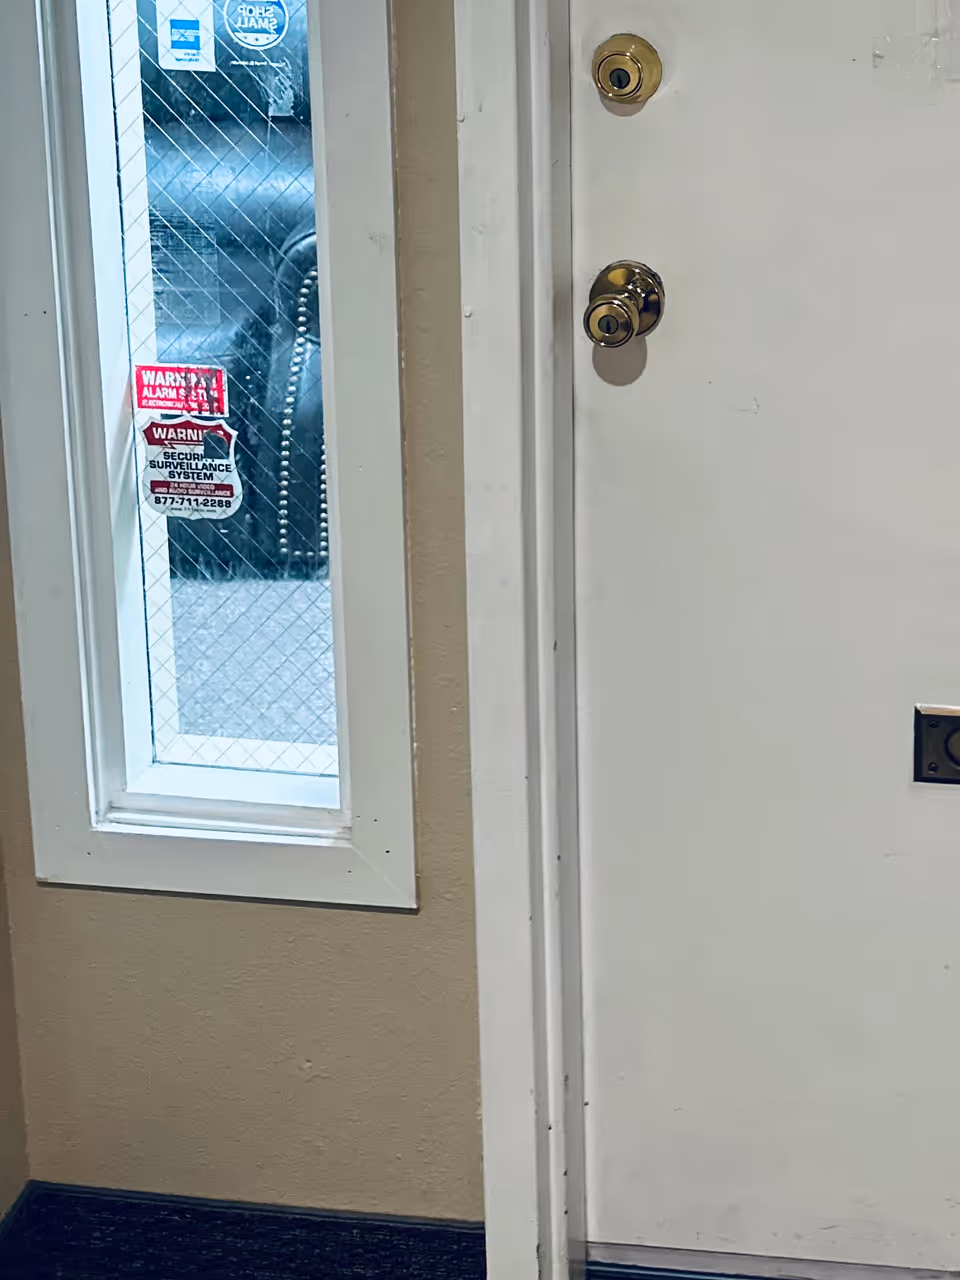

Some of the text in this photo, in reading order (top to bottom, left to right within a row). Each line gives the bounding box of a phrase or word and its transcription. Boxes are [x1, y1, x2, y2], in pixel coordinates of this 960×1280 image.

[142, 387, 176, 399] ALARM
[149, 461, 232, 472] SURVEILLANCE
[169, 471, 214, 481] SYSTEM
[155, 497, 231, 508] 877-711-2288
